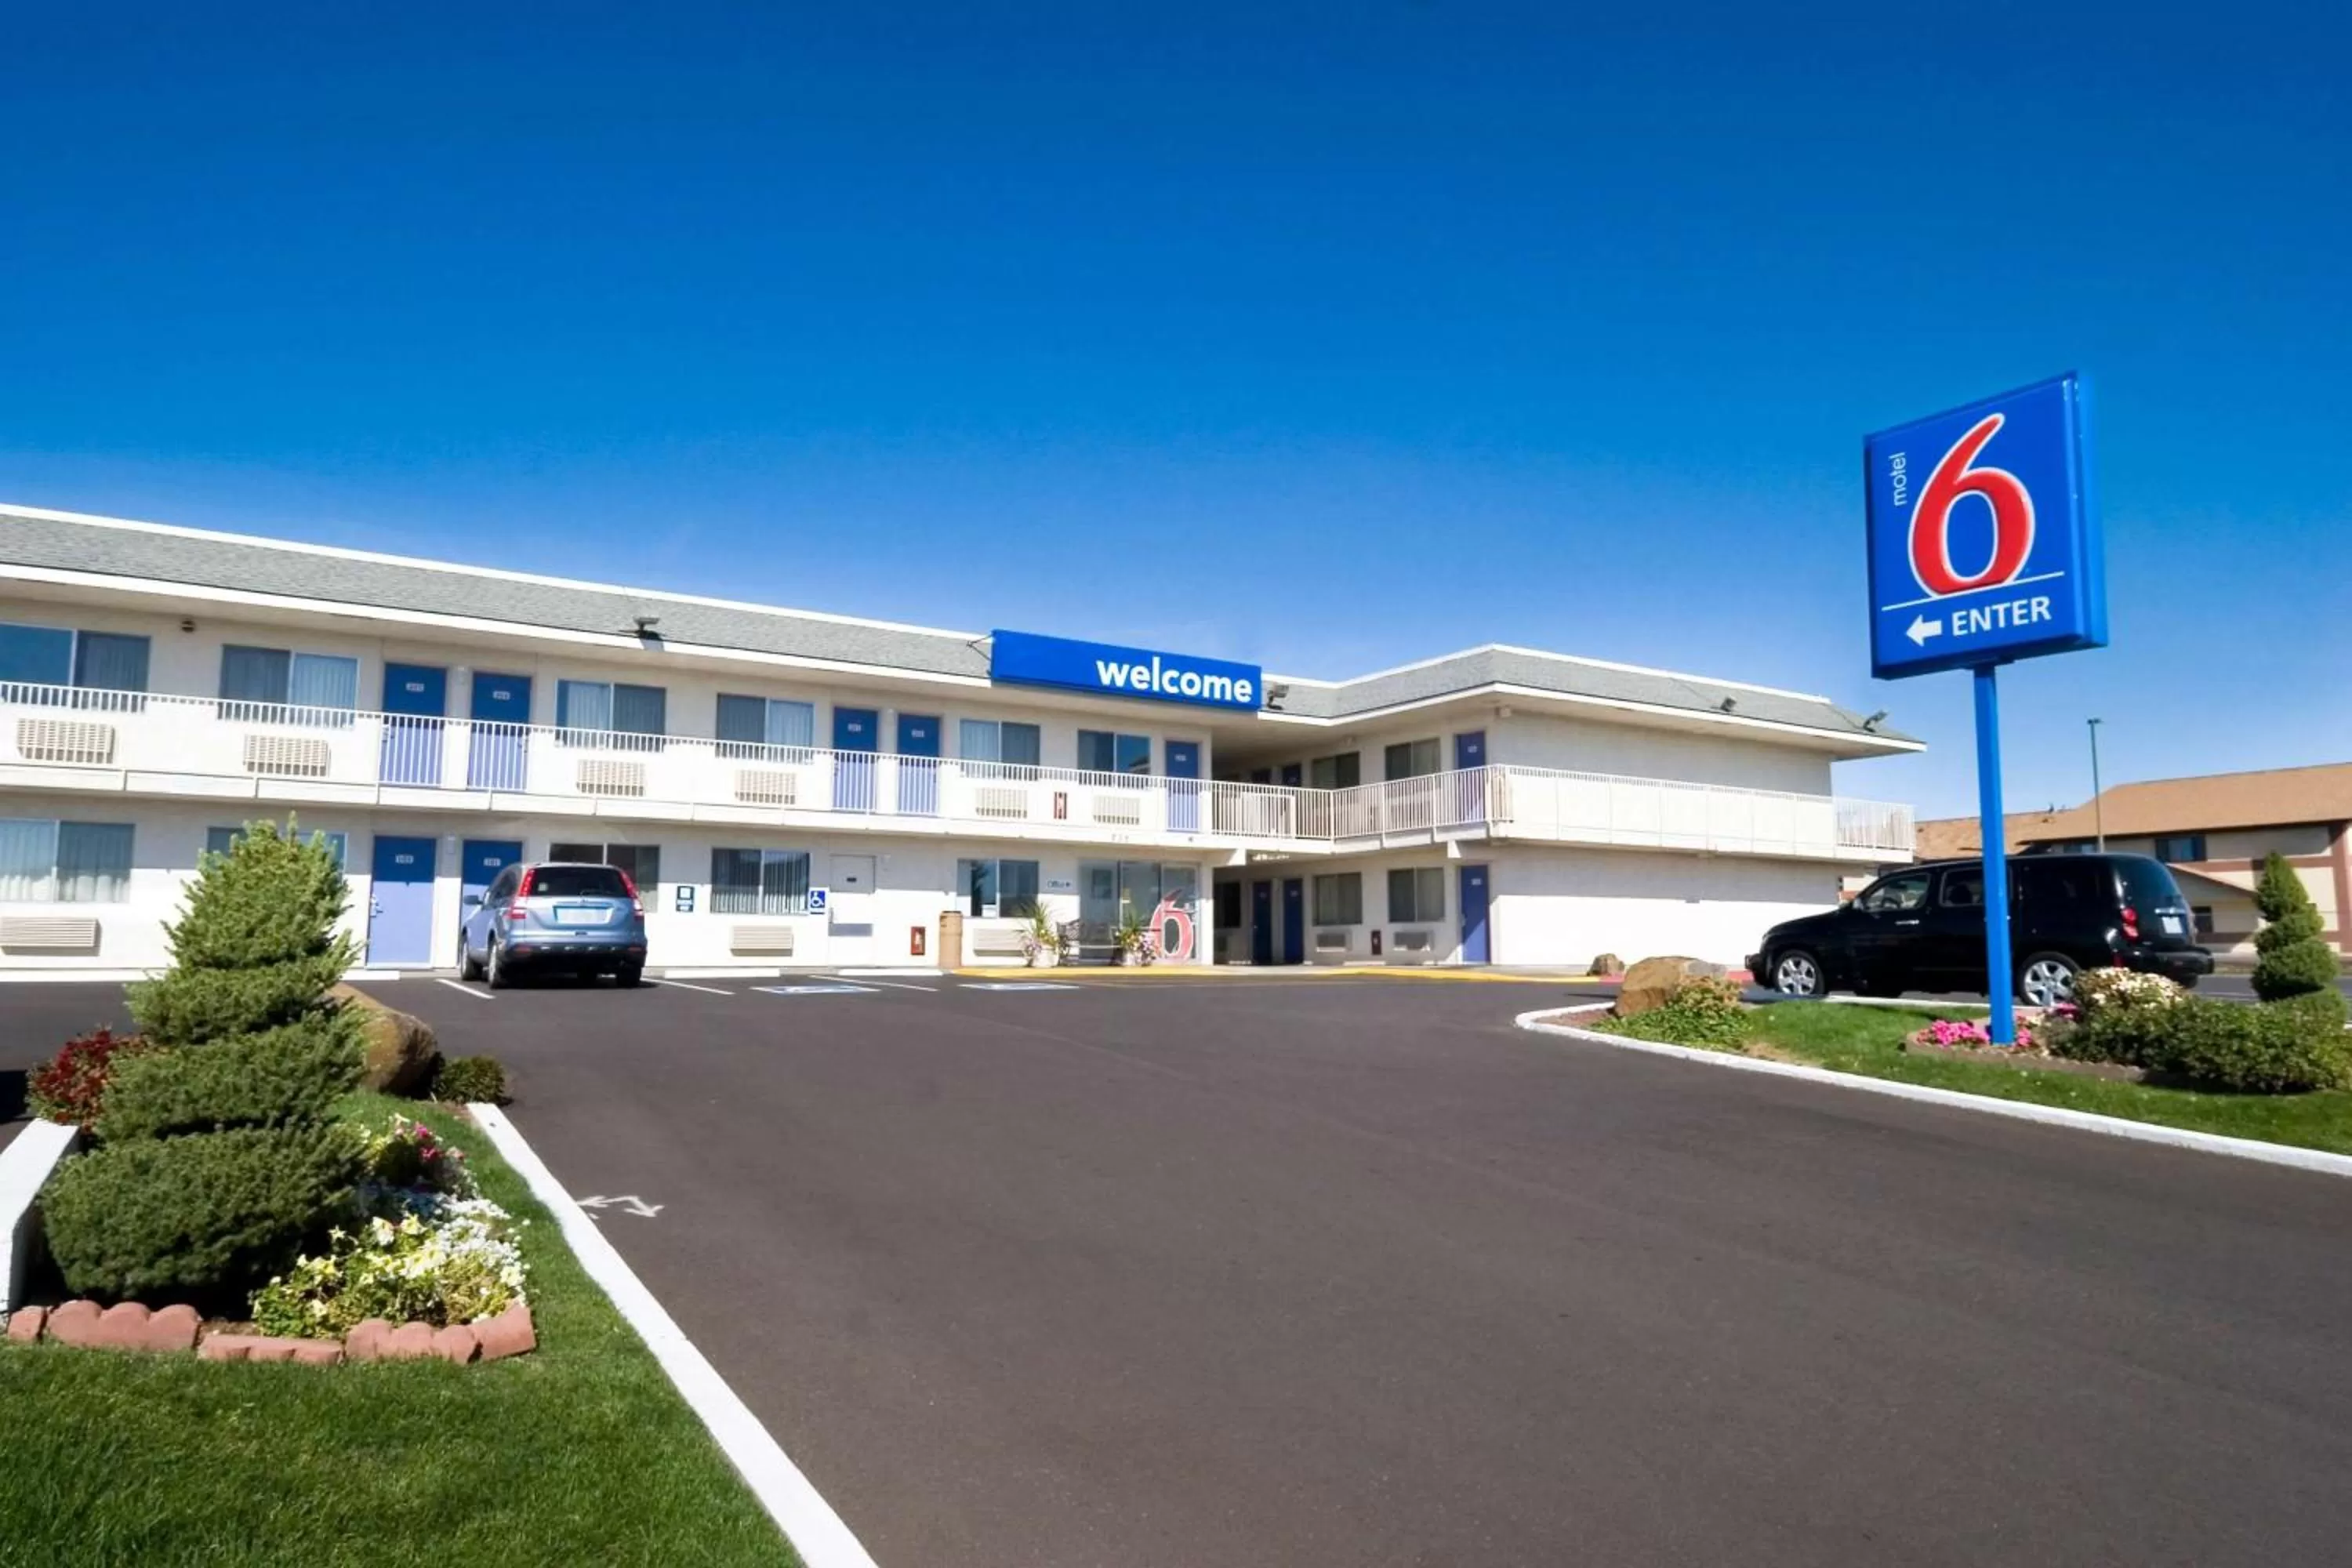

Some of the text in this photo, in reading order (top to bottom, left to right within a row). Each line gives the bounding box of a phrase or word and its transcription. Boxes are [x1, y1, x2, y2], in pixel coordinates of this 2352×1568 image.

[1888, 452, 1907, 507] motel
[1907, 412, 2035, 599] 6
[1951, 596, 2052, 637] ENTER
[1096, 657, 1253, 703] welcome
[1149, 888, 1194, 960] 6
